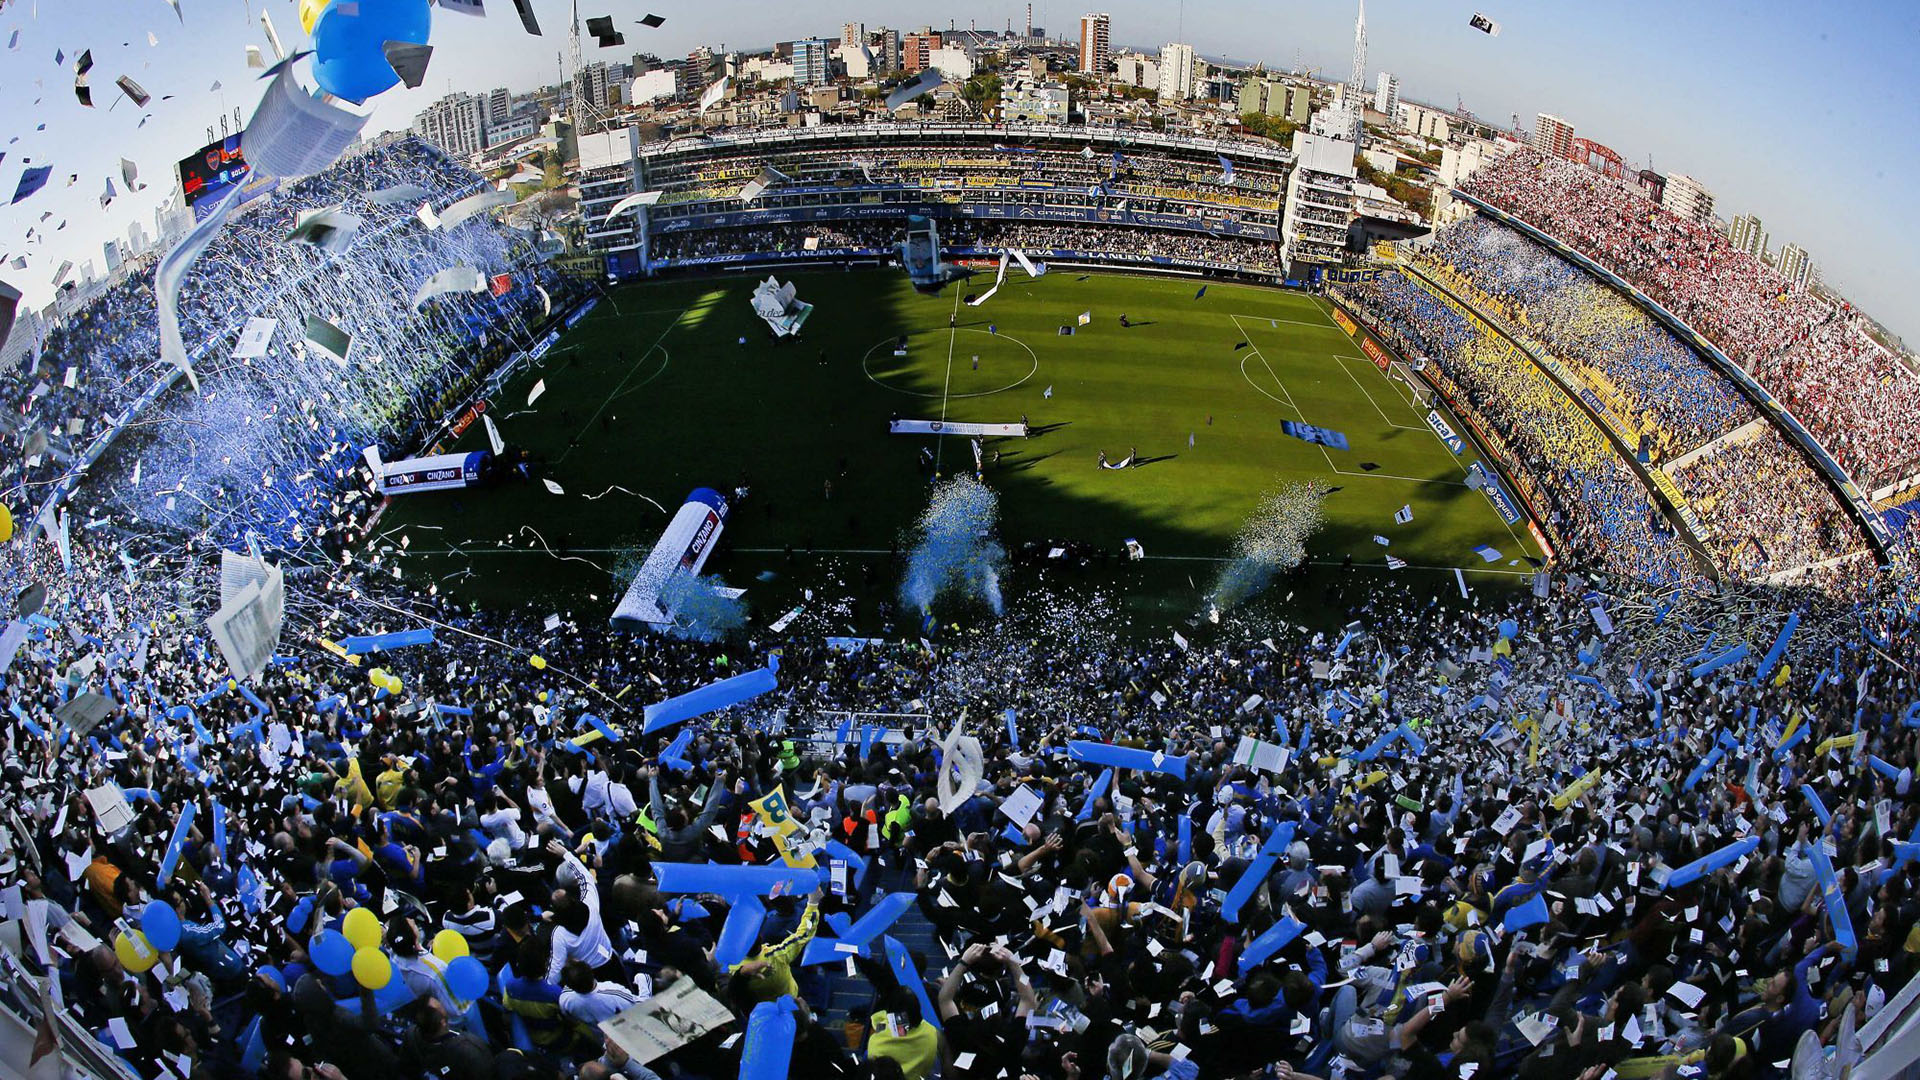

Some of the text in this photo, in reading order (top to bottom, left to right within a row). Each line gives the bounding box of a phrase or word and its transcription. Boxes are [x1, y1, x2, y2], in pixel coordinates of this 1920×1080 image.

[800, 248, 844, 257] NUEVA
[1108, 252, 1153, 262] NUEVA
[1327, 268, 1382, 283] BUDGE
[1487, 330, 1511, 351] LADO
[1509, 348, 1536, 371] BOCA
[1534, 368, 1569, 404] JUNIORS
[1566, 401, 1607, 443] QUERIDO
[1428, 413, 1450, 436] sica
[426, 469, 455, 480] CINZANO
[1493, 492, 1516, 521] Seguros
[1679, 506, 1708, 538] LANUS
[692, 520, 714, 553] CINZANO
[761, 791, 786, 824] B
